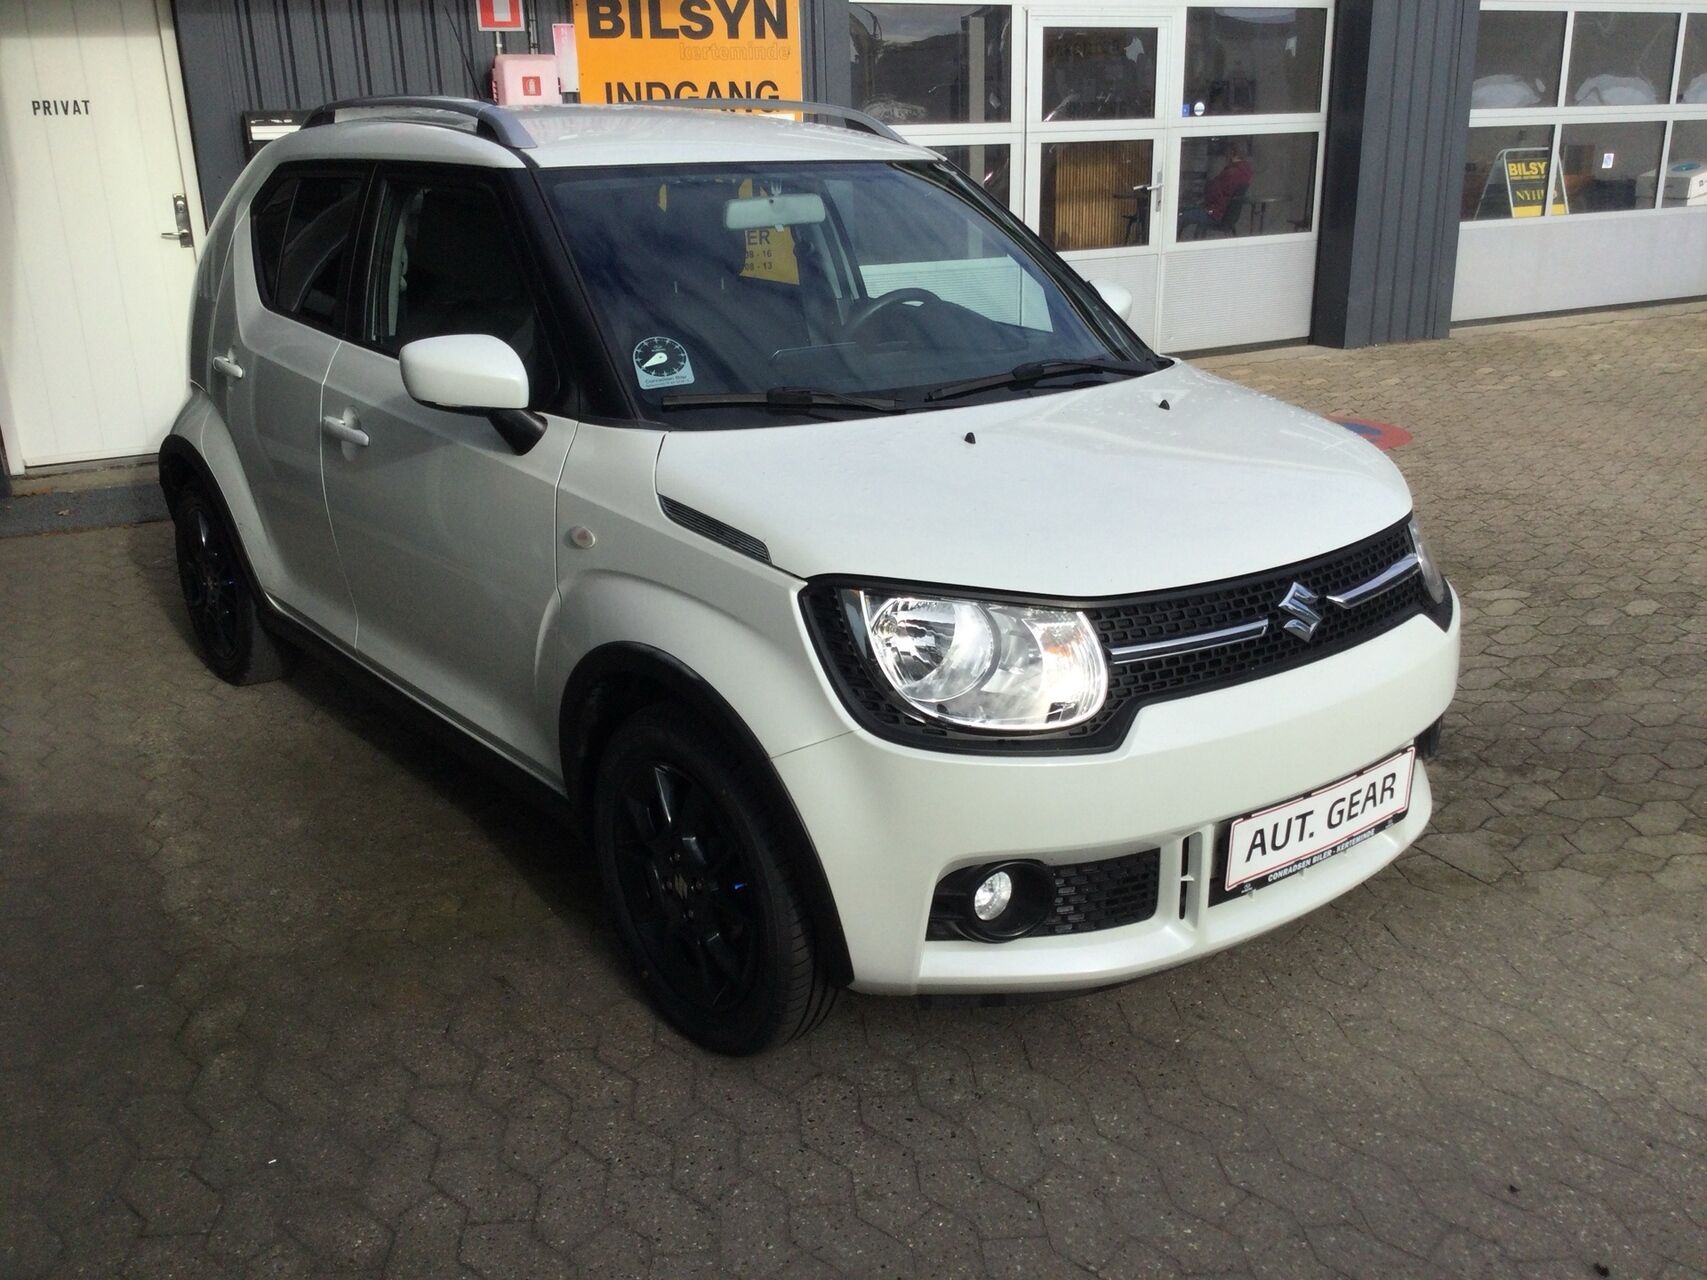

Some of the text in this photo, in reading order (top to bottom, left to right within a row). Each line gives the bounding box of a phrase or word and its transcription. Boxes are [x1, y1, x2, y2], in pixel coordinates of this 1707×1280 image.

[586, 0, 789, 40] BILSYN
[679, 42, 790, 60] kerteminde
[32, 100, 90, 116] PRIVAT
[605, 80, 780, 112] INDGANG
[1508, 162, 1548, 176] BILSY
[1245, 772, 1397, 863] AUT. GEAR
[1267, 858, 1312, 882] CONRADSEN
[1312, 849, 1333, 864] BILER
